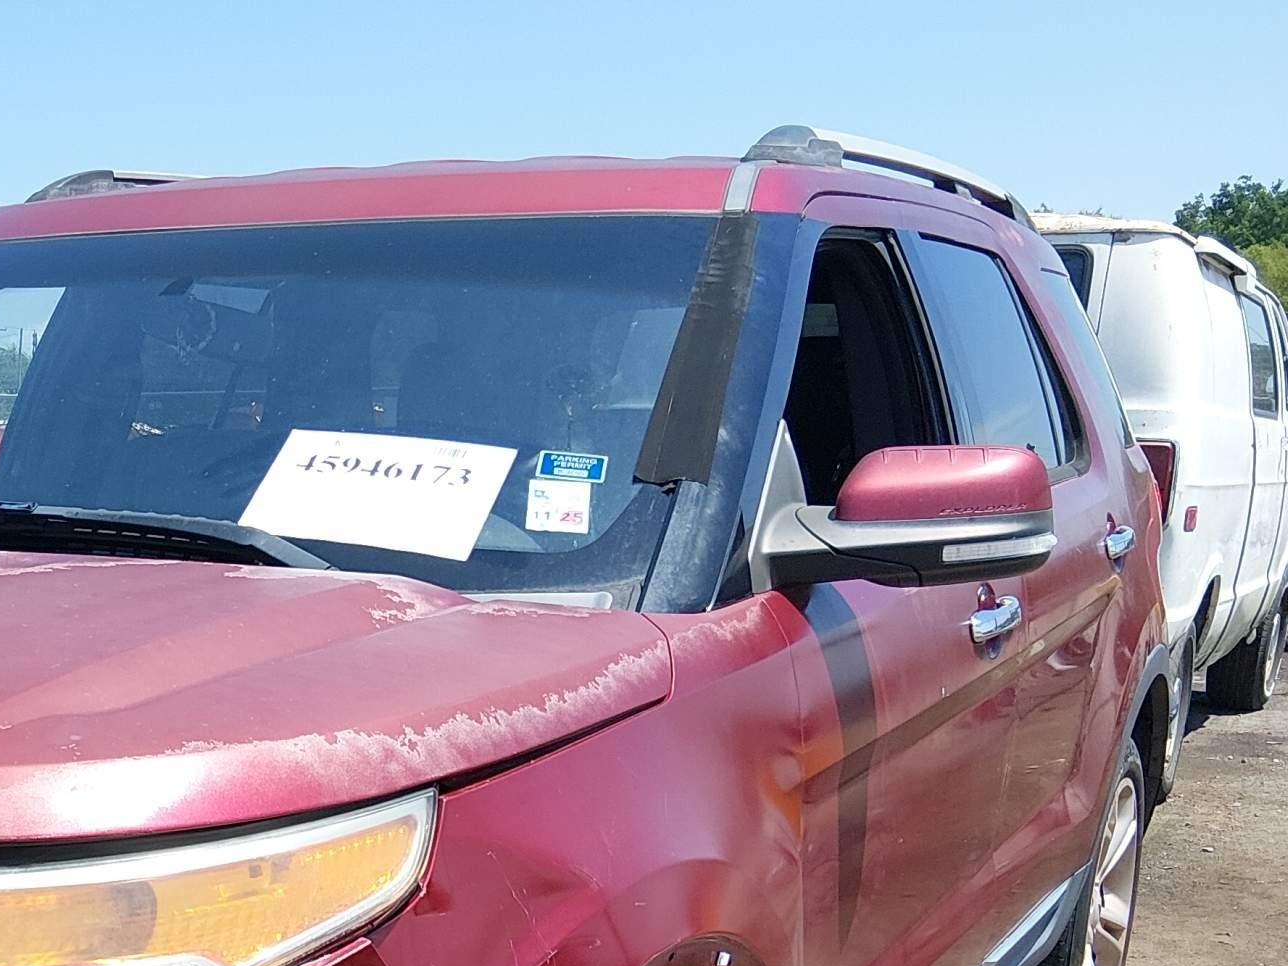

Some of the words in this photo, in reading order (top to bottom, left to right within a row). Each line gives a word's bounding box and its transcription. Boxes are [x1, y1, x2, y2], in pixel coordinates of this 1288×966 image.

[551, 454, 598, 465] PARKING
[554, 460, 593, 469] PERMIT
[296, 454, 472, 486] 45946173
[939, 503, 1028, 516] EXPLORER
[534, 511, 550, 521] 11
[560, 511, 584, 525] 25
